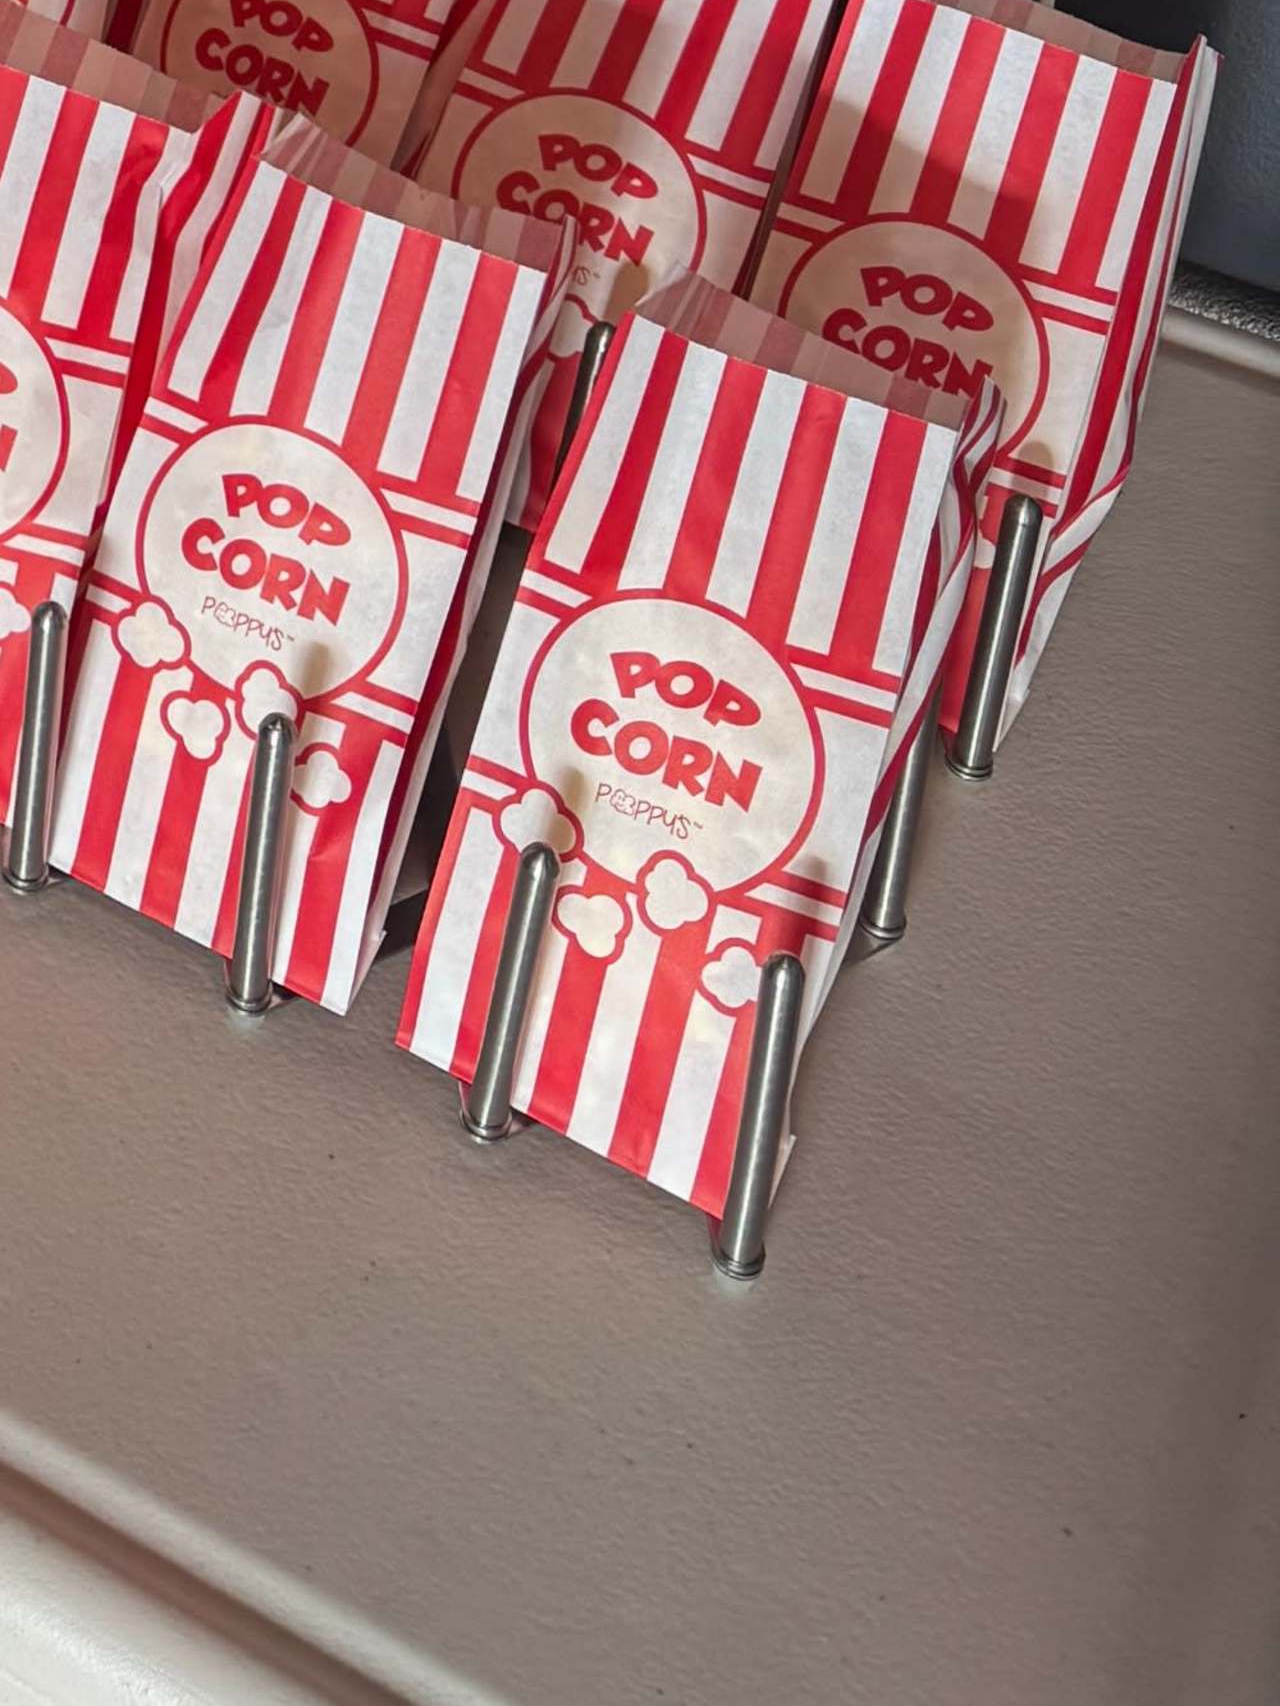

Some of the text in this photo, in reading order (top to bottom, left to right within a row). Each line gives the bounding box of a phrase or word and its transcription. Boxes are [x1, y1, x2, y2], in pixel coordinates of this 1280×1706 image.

[195, 27, 330, 116] CORN
[538, 133, 659, 200] POP
[496, 170, 653, 267] CORN
[860, 266, 994, 334] POP
[823, 315, 994, 400] CORN
[221, 472, 352, 548] POP
[180, 537, 350, 628] CORN
[609, 650, 762, 729] POP
[569, 699, 763, 813] CORN
